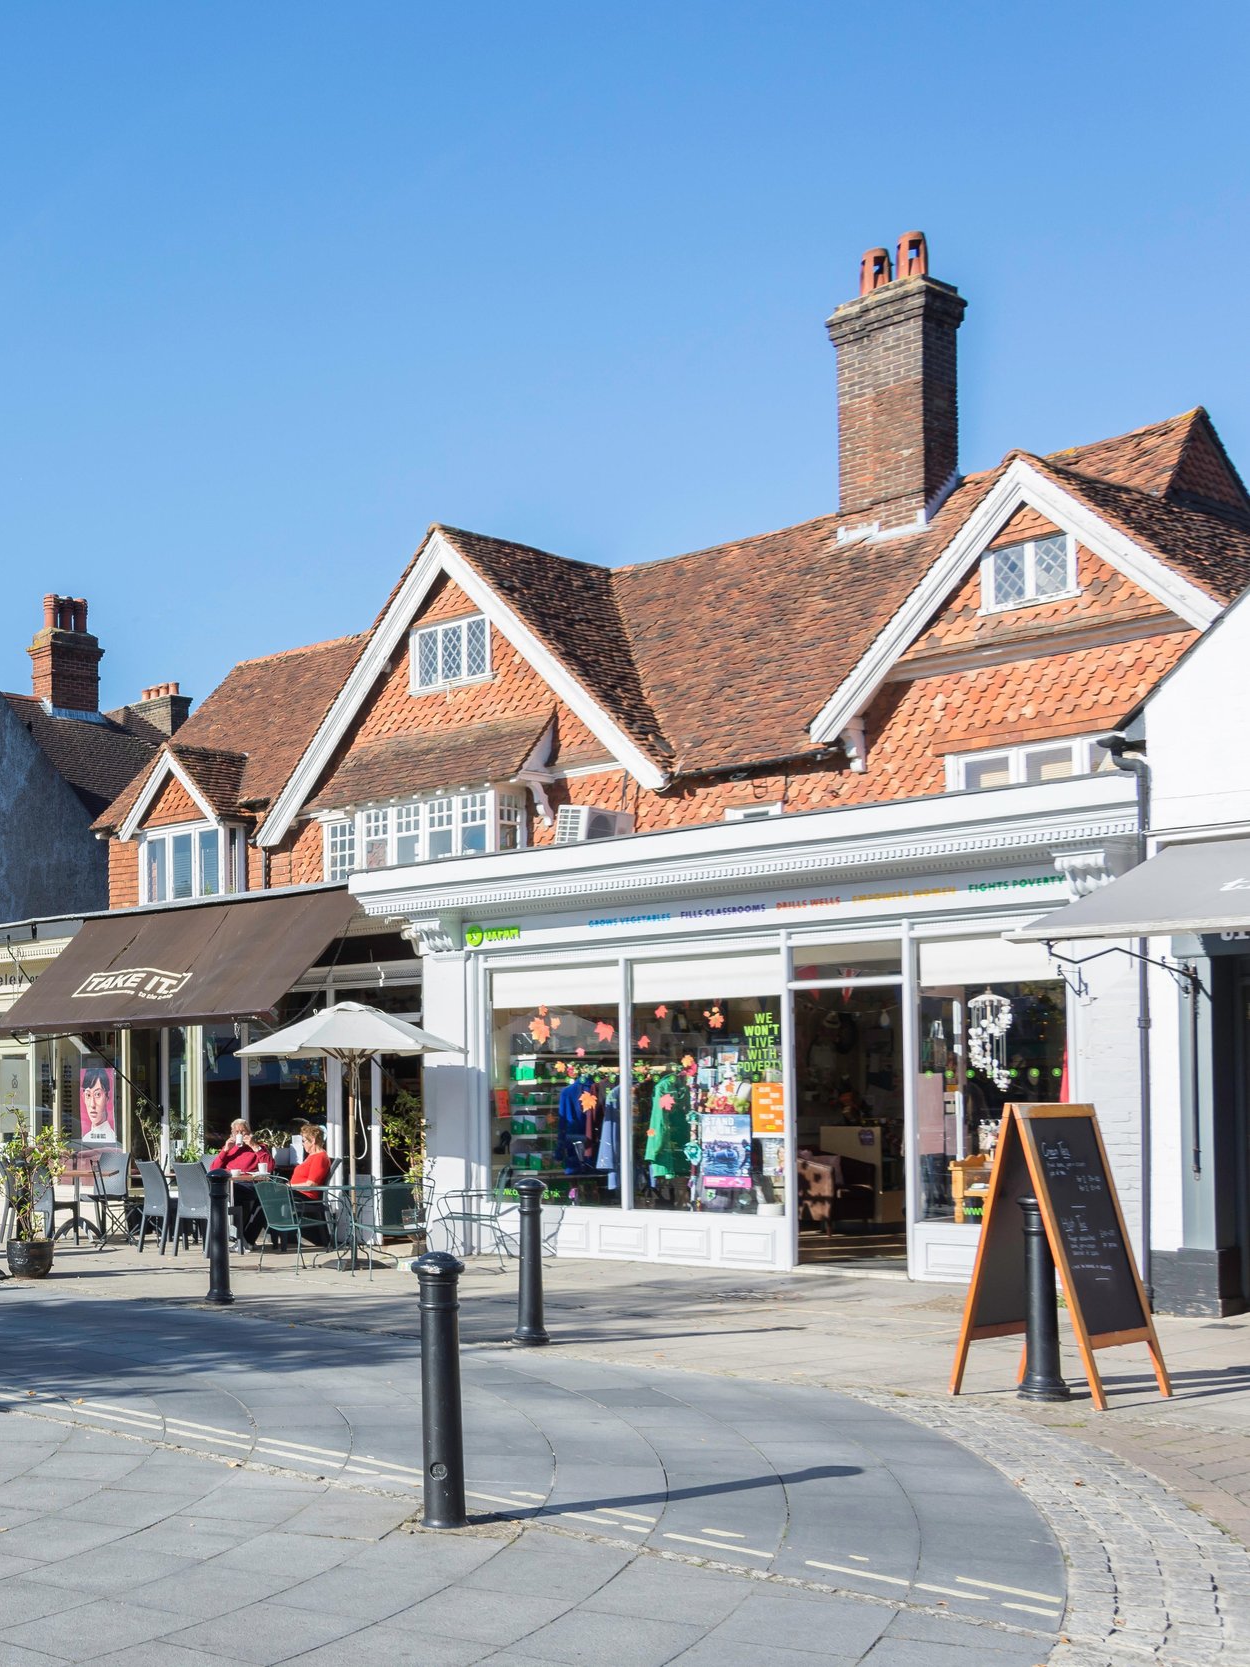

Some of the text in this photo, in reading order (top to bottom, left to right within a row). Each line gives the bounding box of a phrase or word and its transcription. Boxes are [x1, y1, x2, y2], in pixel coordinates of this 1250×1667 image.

[967, 875, 1066, 893] FIGHTS POVERTY
[775, 896, 841, 911] DRILLS WELLS
[680, 903, 766, 920] FILLS CLASSROOMS
[588, 912, 671, 928] GROWS VEGETABLES
[86, 973, 147, 991] TAKE
[754, 1012, 773, 1024] WE
[743, 1024, 779, 1036] WON'T
[749, 1036, 774, 1048] LIVE
[747, 1048, 777, 1060] WITH
[737, 1060, 782, 1072] POVERTY
